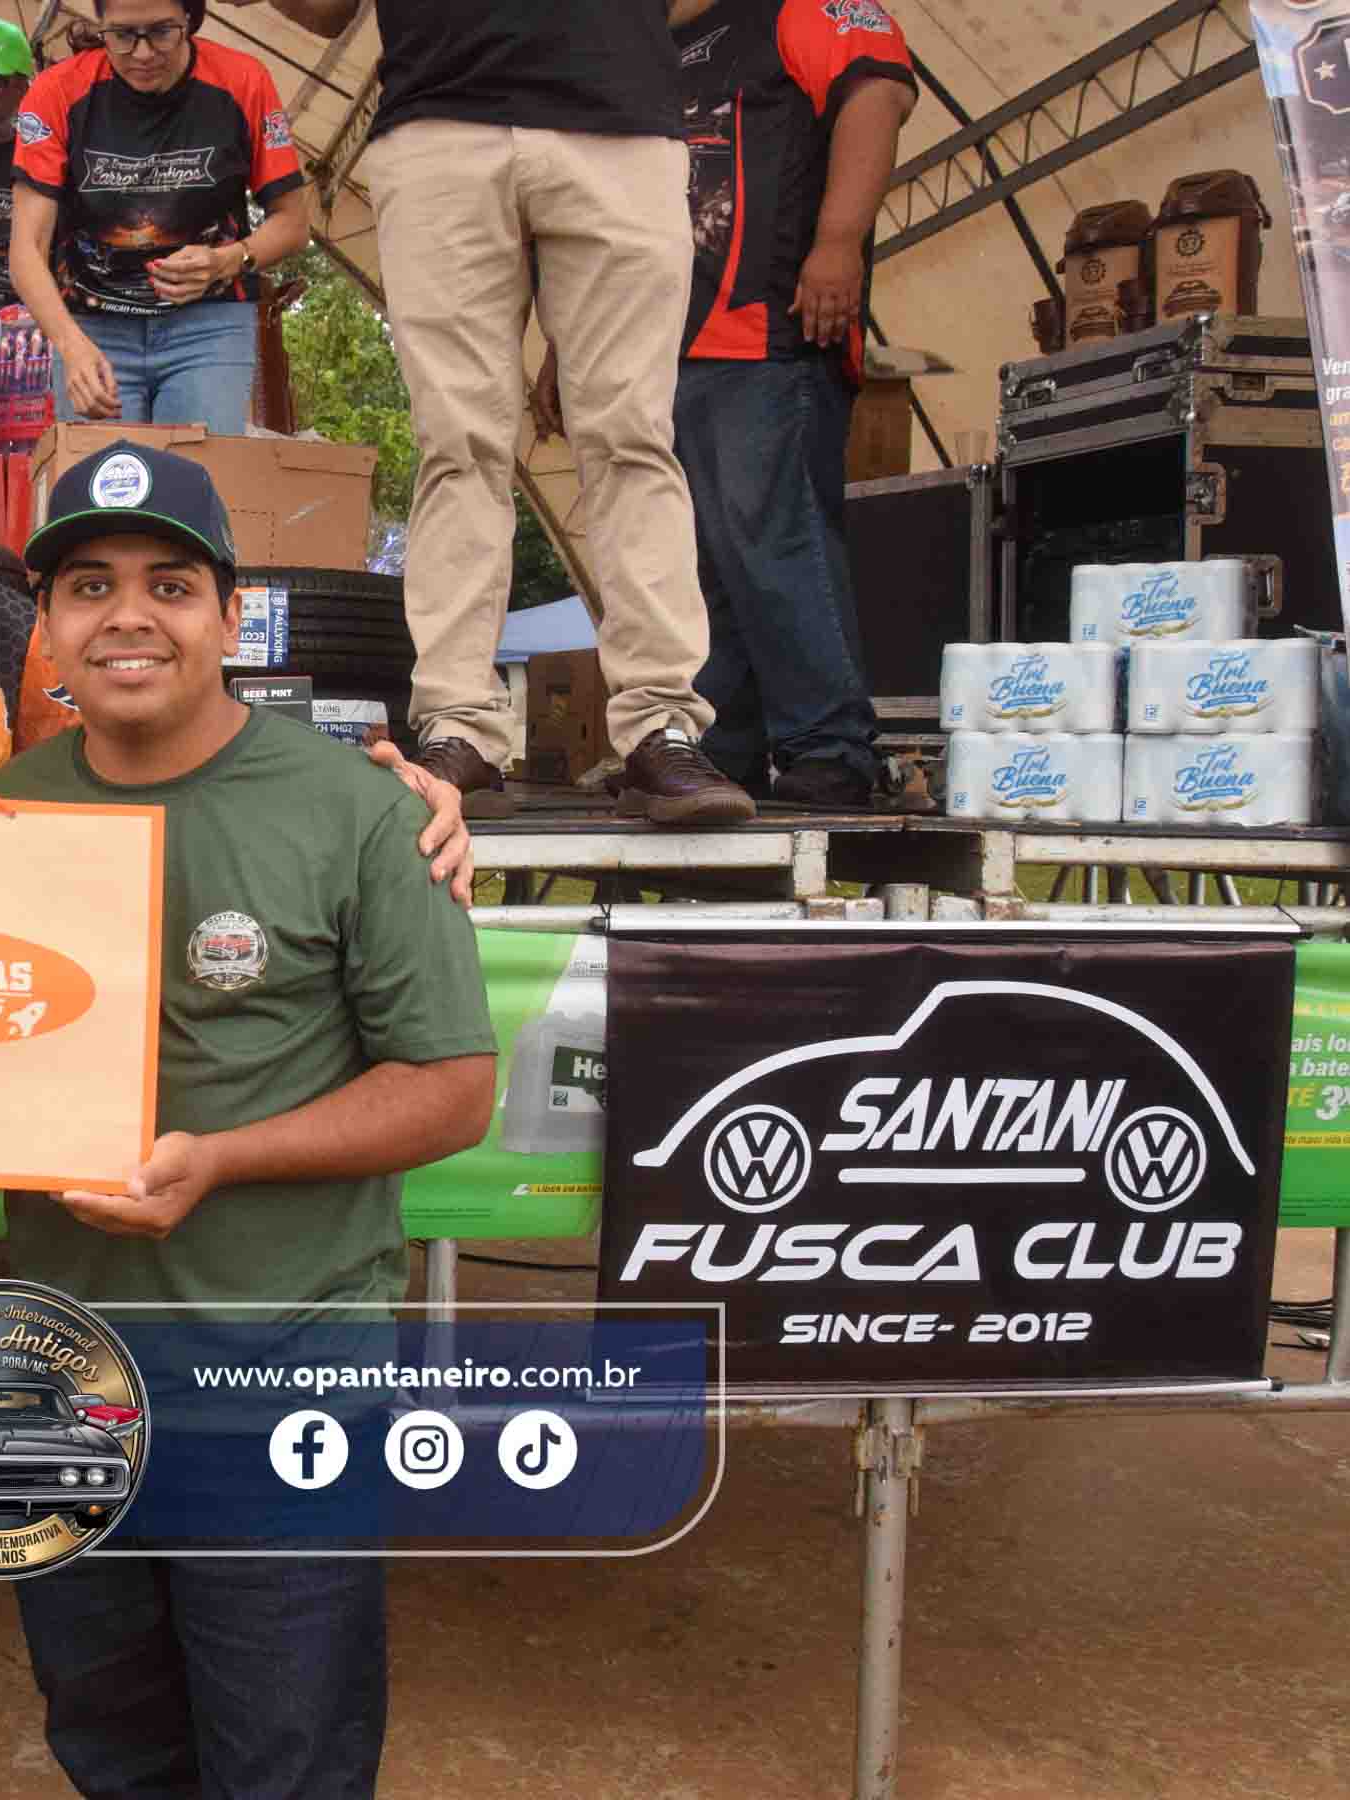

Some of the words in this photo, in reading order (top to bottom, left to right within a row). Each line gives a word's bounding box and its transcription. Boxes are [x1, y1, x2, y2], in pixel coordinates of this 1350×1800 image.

[1322, 358, 1350, 376] Ven
[1326, 385, 1350, 404] gra
[1122, 592, 1196, 619] Buena
[240, 631, 265, 641] ECOT
[273, 608, 285, 664] PALLYKING
[243, 689, 267, 698] BEER
[271, 688, 293, 698] PINT
[988, 676, 1066, 701] Buena
[1186, 673, 1268, 700] Buena
[992, 766, 1066, 791] Buena
[1173, 767, 1254, 792] Buena
[1291, 1036, 1322, 1053] ais
[1302, 1059, 1350, 1077] bate
[1288, 1083, 1317, 1107] TÉ
[819, 1077, 1127, 1152] SANTANI
[619, 1223, 981, 1281] FUSCA
[1013, 1221, 1243, 1280] CLUB
[779, 1312, 955, 1344] SINCE-
[968, 1312, 1092, 1343] 2012
